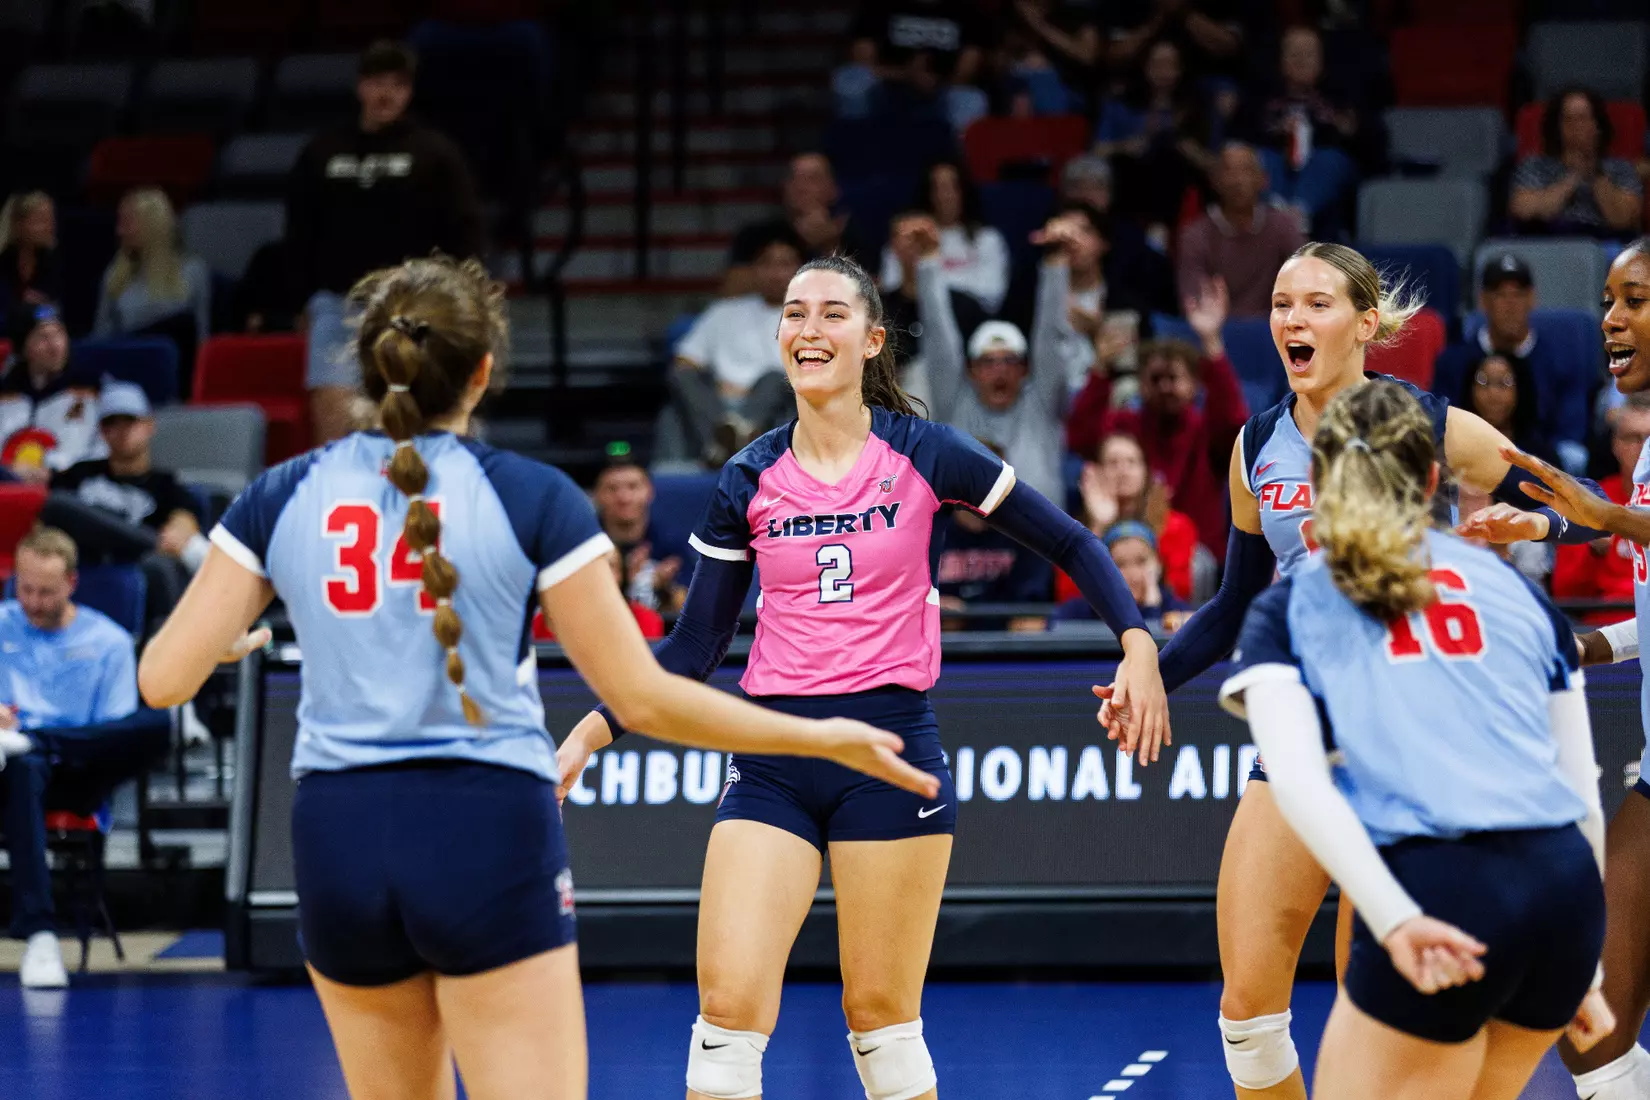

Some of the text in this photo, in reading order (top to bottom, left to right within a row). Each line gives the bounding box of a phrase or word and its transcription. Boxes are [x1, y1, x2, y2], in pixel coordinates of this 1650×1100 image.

[767, 502, 901, 538] LIBERTY
[815, 543, 854, 604] 2
[567, 750, 733, 805] CHBU
[941, 746, 1142, 801] IONAL
